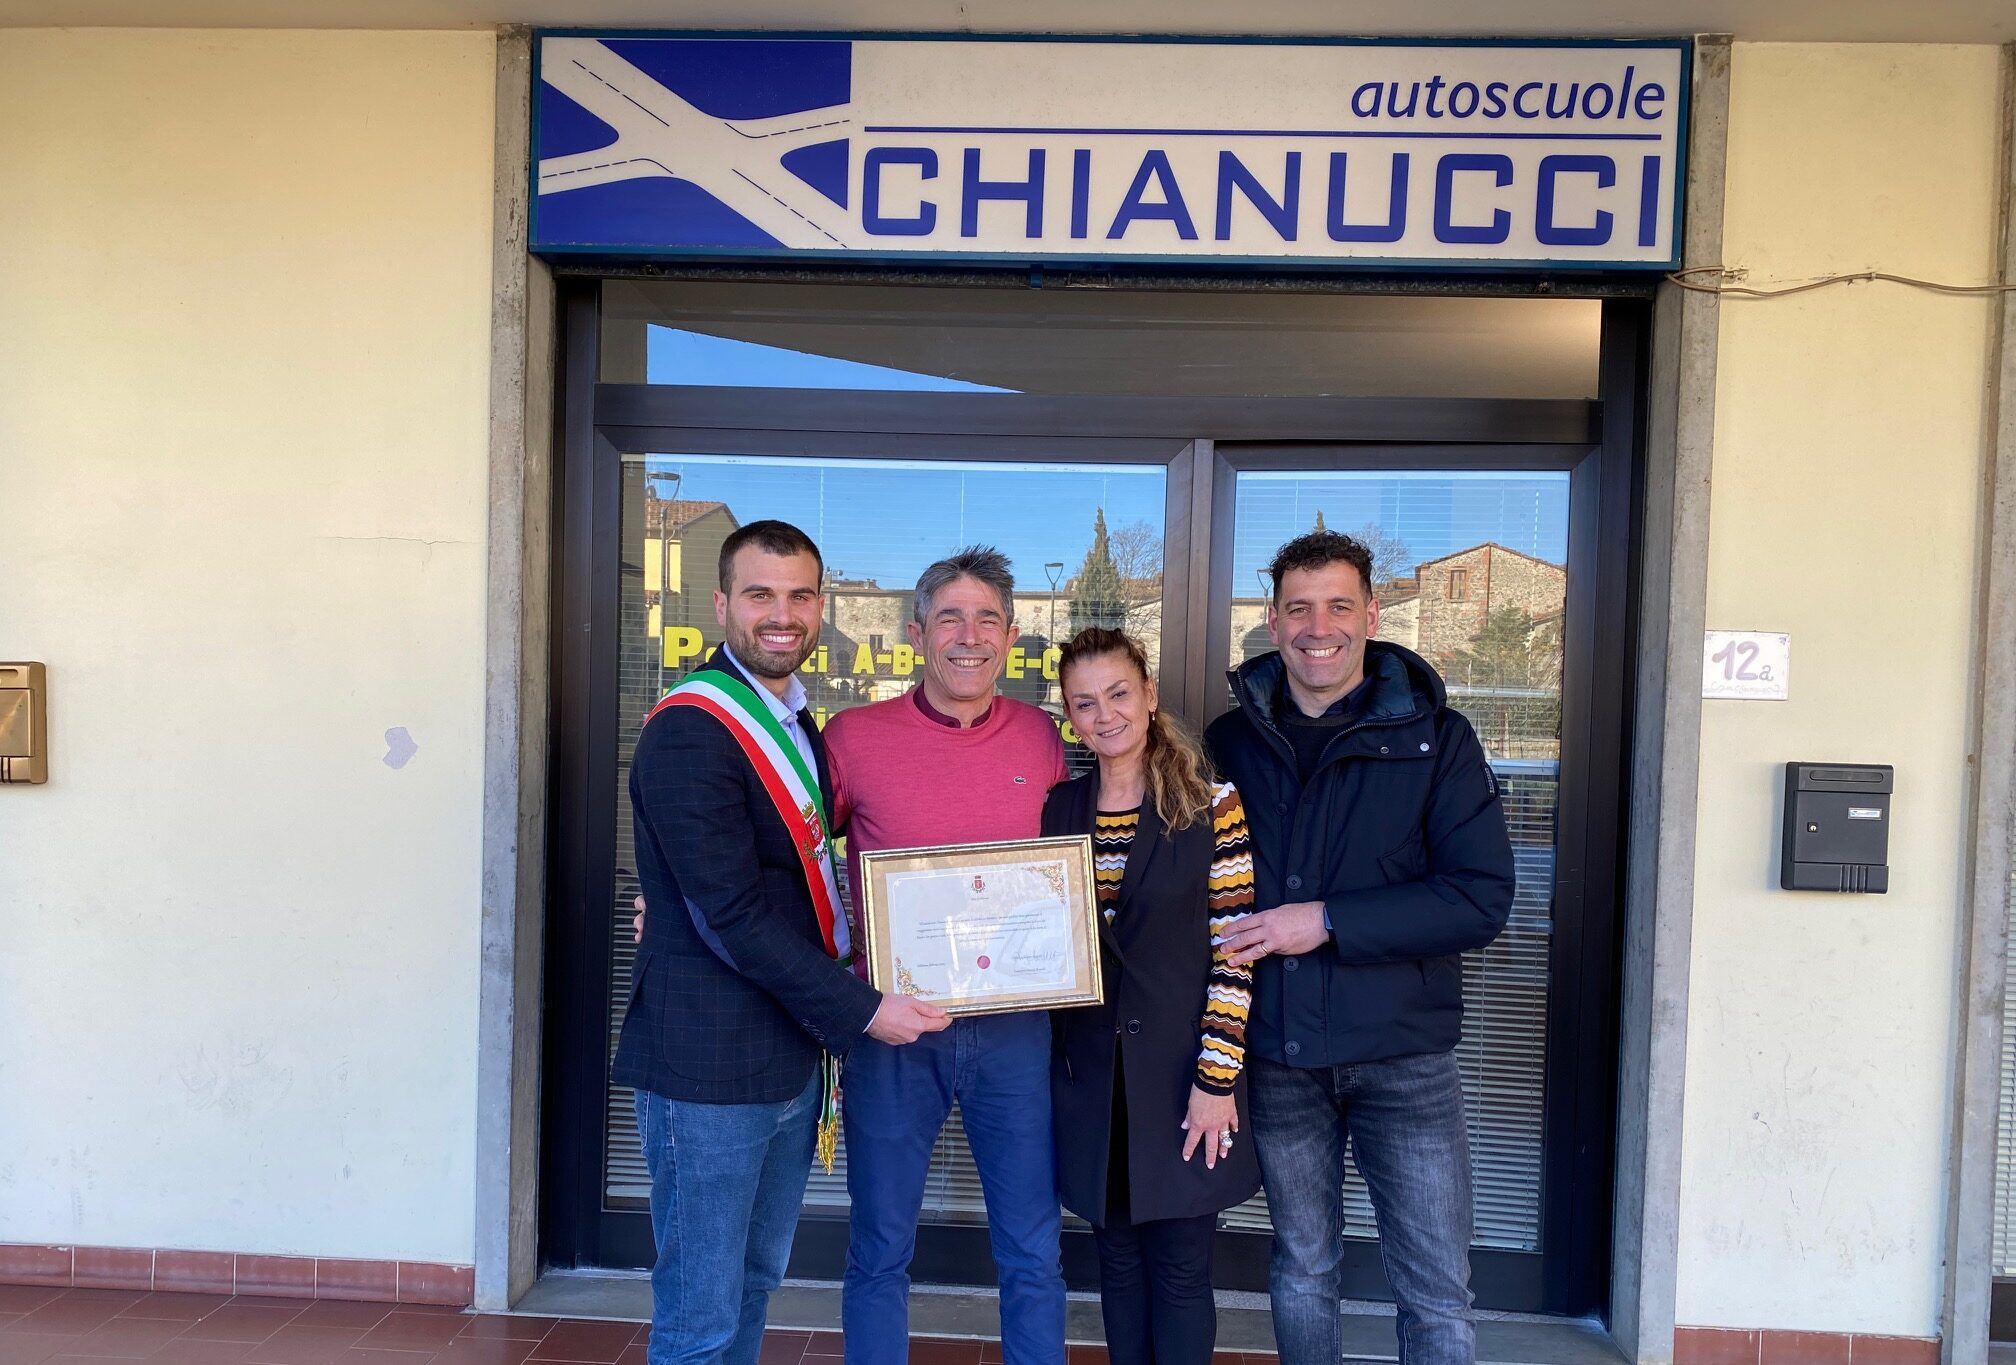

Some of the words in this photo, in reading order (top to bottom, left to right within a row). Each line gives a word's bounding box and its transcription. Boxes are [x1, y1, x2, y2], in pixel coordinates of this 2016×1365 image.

[1351, 66, 1665, 120] autoscuole
[861, 146, 1661, 247] CHIANUCCI
[1711, 640, 1774, 682] 12a
